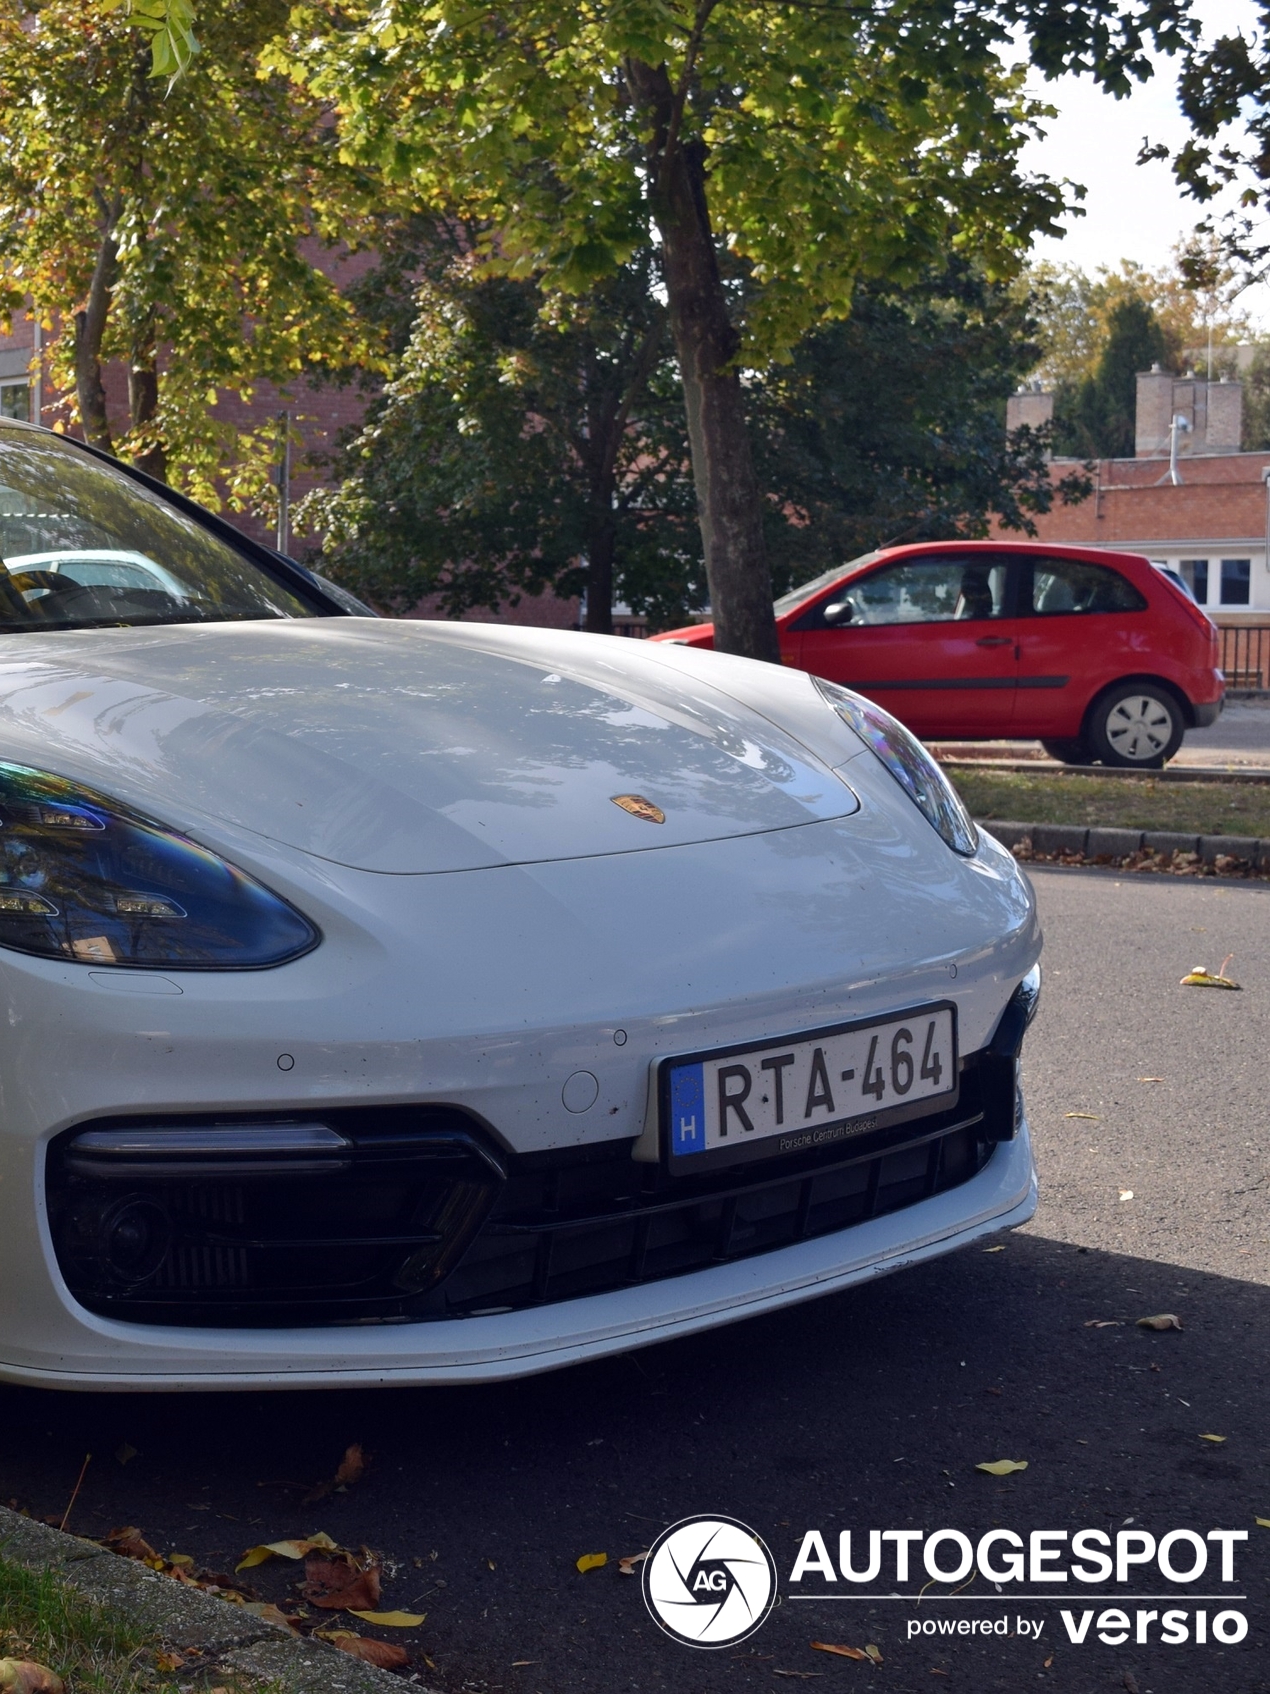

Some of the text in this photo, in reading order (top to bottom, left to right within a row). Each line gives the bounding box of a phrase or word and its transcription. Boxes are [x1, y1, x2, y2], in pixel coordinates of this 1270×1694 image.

[718, 1021, 942, 1137] RTA-464
[680, 1115, 696, 1142] H
[779, 1116, 878, 1150] Porsche Centrum Budapest
